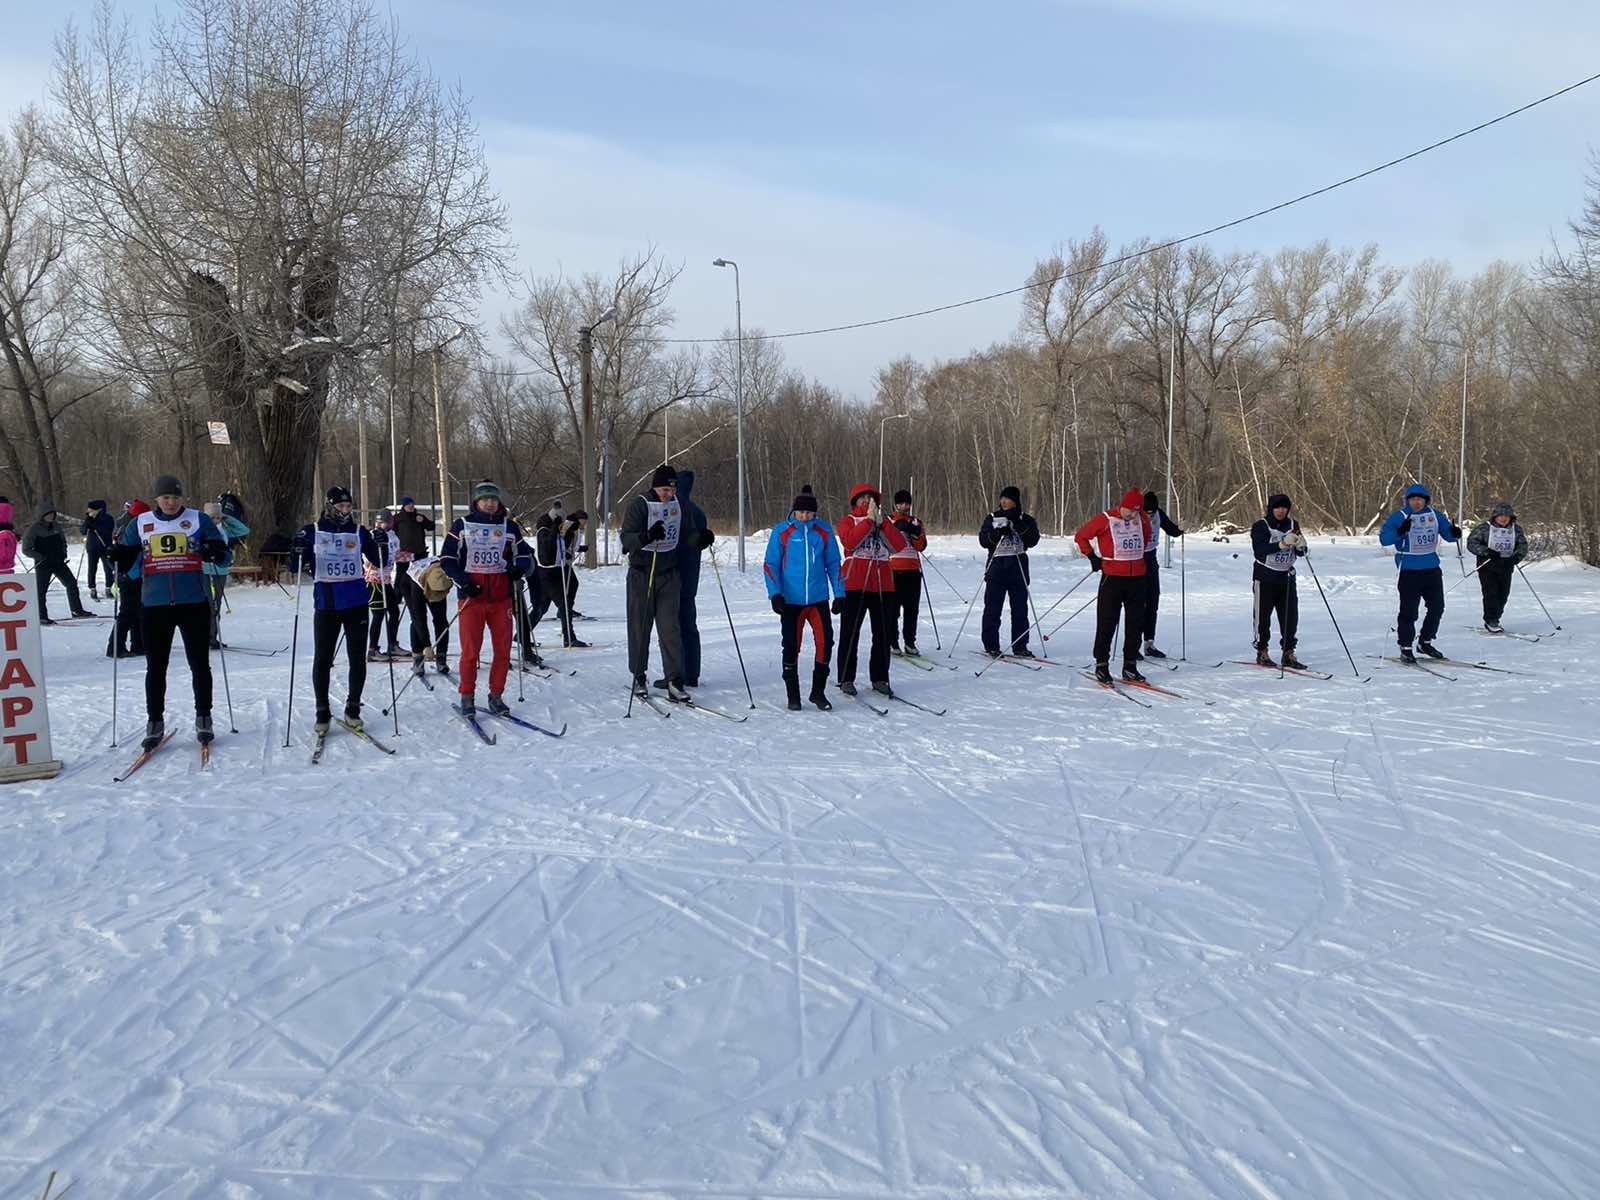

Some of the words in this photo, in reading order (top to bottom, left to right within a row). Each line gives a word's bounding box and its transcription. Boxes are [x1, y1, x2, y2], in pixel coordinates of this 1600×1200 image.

[160, 534, 177, 554] 9
[1122, 537, 1142, 550] 6672
[473, 551, 500, 564] 6939
[327, 562, 356, 577] 6549
[0, 581, 38, 766] СТАРТ
